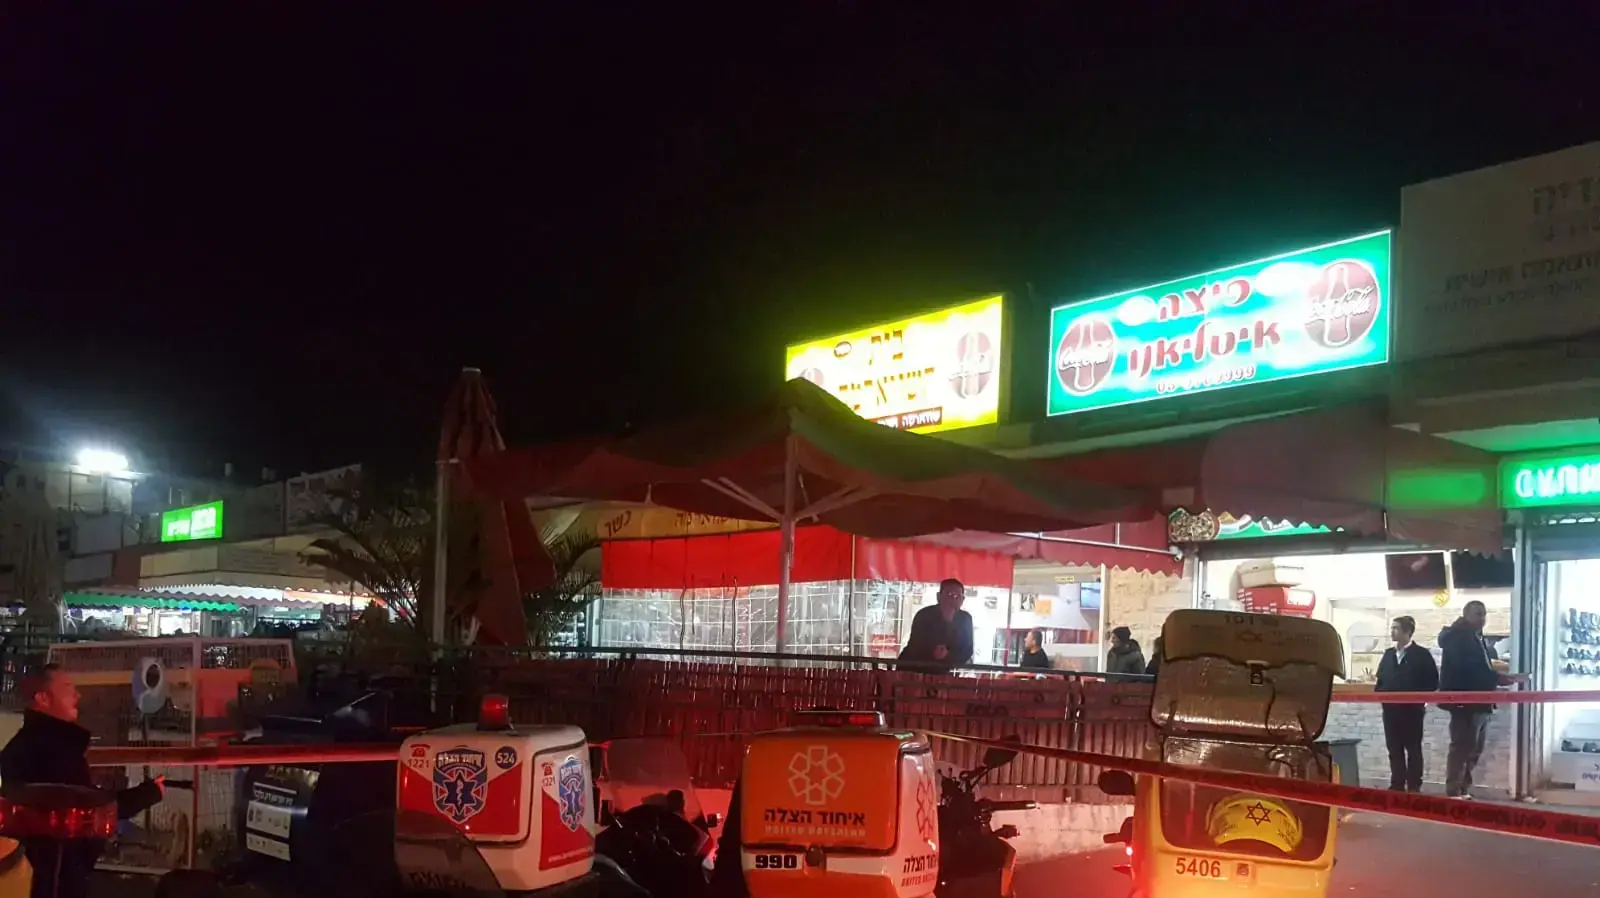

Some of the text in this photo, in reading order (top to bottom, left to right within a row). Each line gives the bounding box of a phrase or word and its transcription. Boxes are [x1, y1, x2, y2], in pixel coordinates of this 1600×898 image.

[1159, 278, 1251, 320] פיצה
[1130, 319, 1281, 378] איטליאנו
[603, 510, 632, 538] כשר
[407, 758, 430, 769] 1221
[496, 752, 515, 765] 524
[764, 807, 864, 826] איחוד הצלה
[755, 854, 798, 869] 990
[903, 855, 925, 874] הצלה
[1175, 856, 1221, 878] 5406
